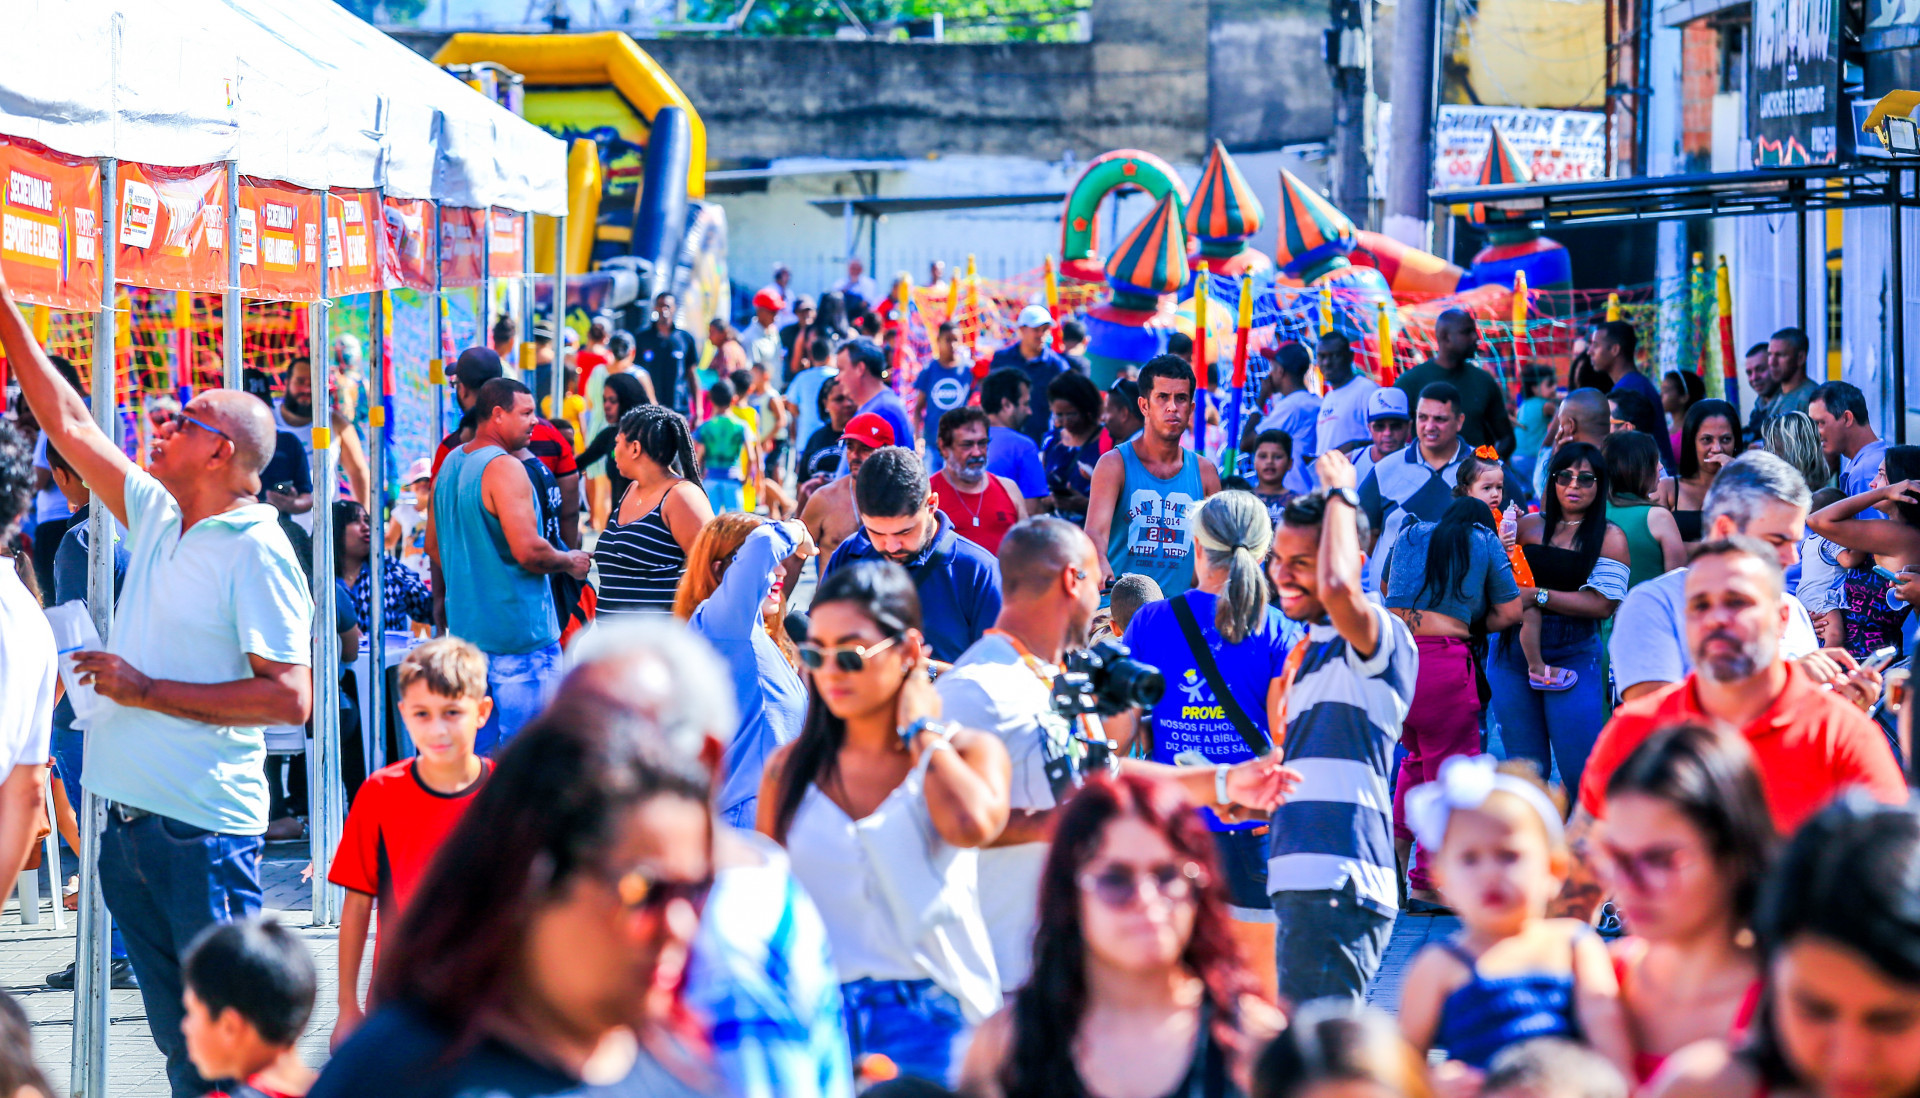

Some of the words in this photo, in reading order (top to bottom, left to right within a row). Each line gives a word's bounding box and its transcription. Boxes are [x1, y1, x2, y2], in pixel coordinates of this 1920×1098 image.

[10, 169, 43, 208] SECRETARIA
[43, 180, 53, 212] DE
[3, 213, 33, 254] ESPORTE
[33, 221, 39, 256] E
[39, 223, 59, 261] LAZER
[1128, 545, 1158, 558] ATHL
[1163, 547, 1188, 561] DEPT
[1181, 705, 1226, 720] PROVE
[1160, 718, 1198, 732] NOSSOS
[1199, 722, 1236, 732] FILHOS
[1171, 731, 1180, 741] O
[1181, 733, 1202, 744] QUE
[1204, 735, 1211, 744] A
[1165, 741, 1180, 752] DIZ
[1204, 746, 1230, 755] ELES
